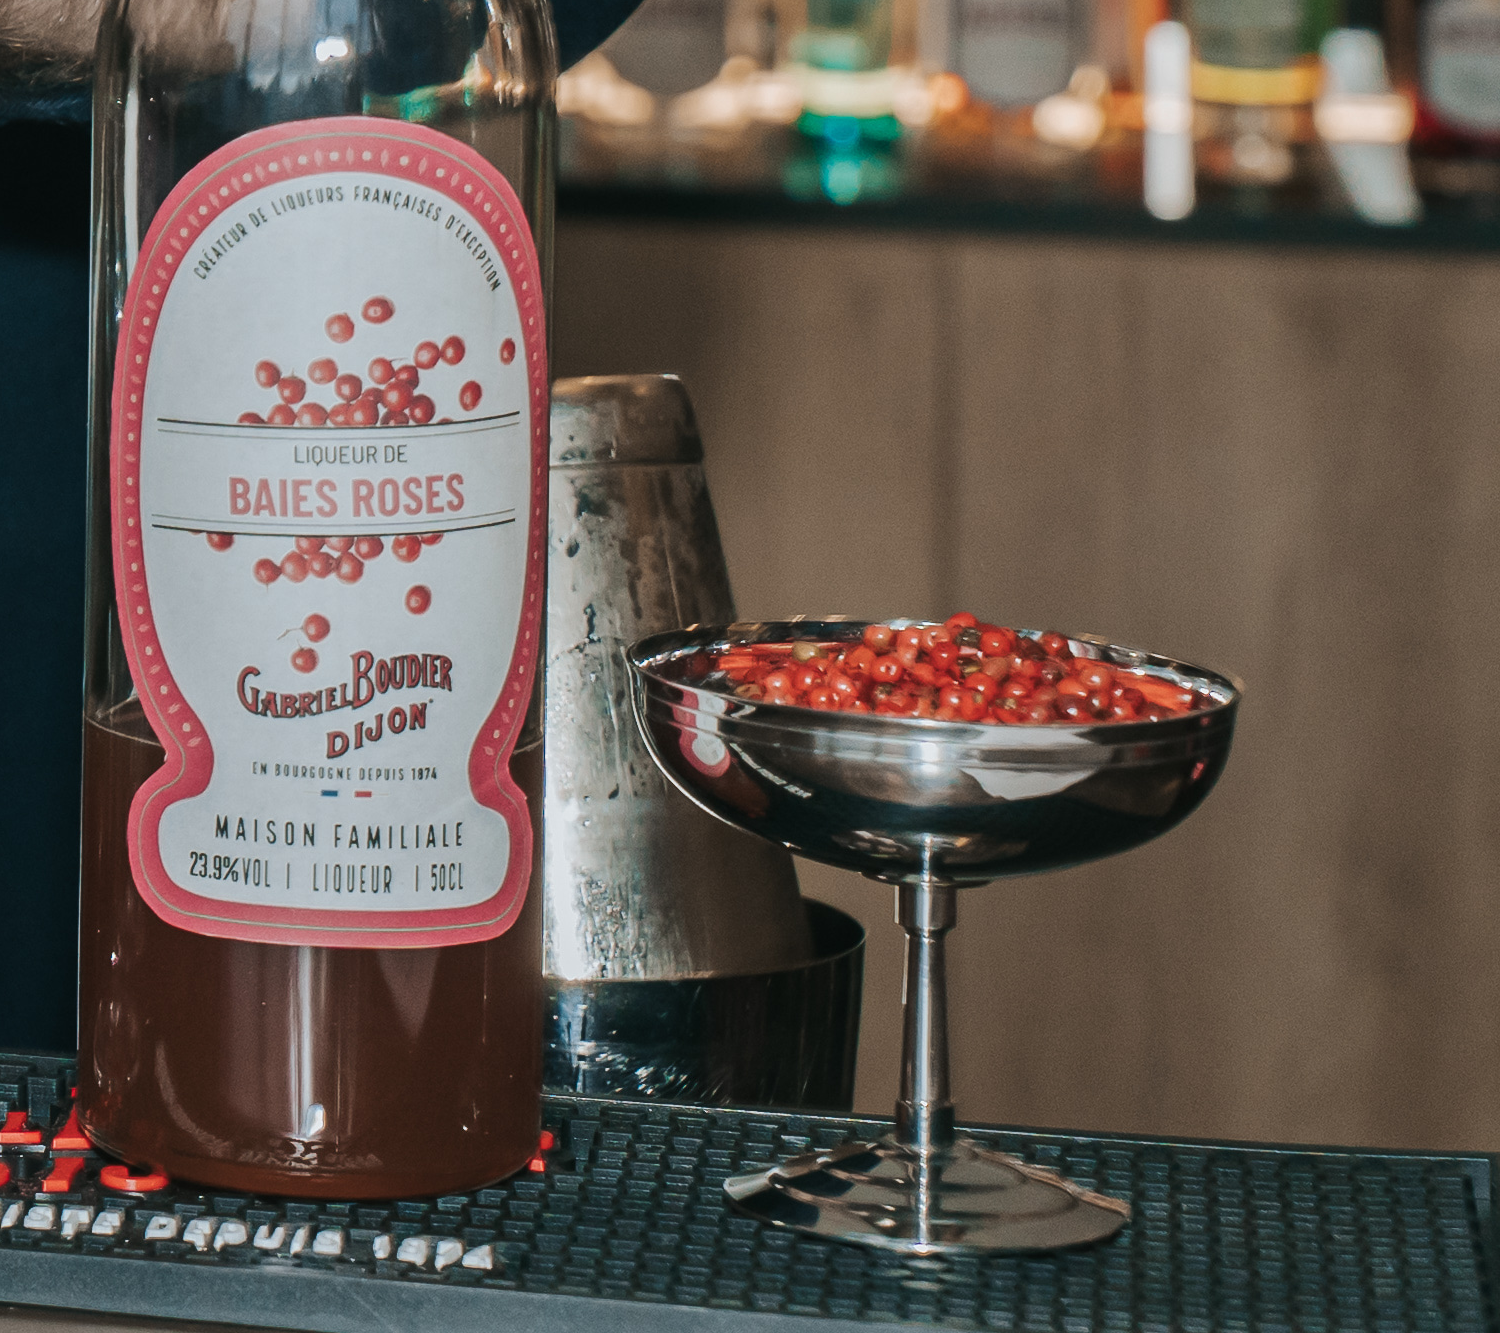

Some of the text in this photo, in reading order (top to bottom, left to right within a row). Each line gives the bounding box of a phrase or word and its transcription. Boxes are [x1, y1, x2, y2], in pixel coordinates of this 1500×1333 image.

[193, 185, 501, 292] CRÉATEUR DE LIQUEURS FRANÇAISES D'EXCEPTION
[294, 444, 408, 466] LIQUEUR DE
[228, 473, 464, 518] BAIES ROSES
[237, 650, 453, 719] GABRIEL BOUDIER
[326, 701, 427, 759] DIJON
[252, 761, 438, 781] EN BOURGOGNE DEPUIS 1874
[215, 814, 463, 849] MAISON FAMILIALE
[313, 863, 392, 893] LIQUEUR
[431, 862, 464, 892] 50CL
[372, 1233, 494, 1271] 1874
